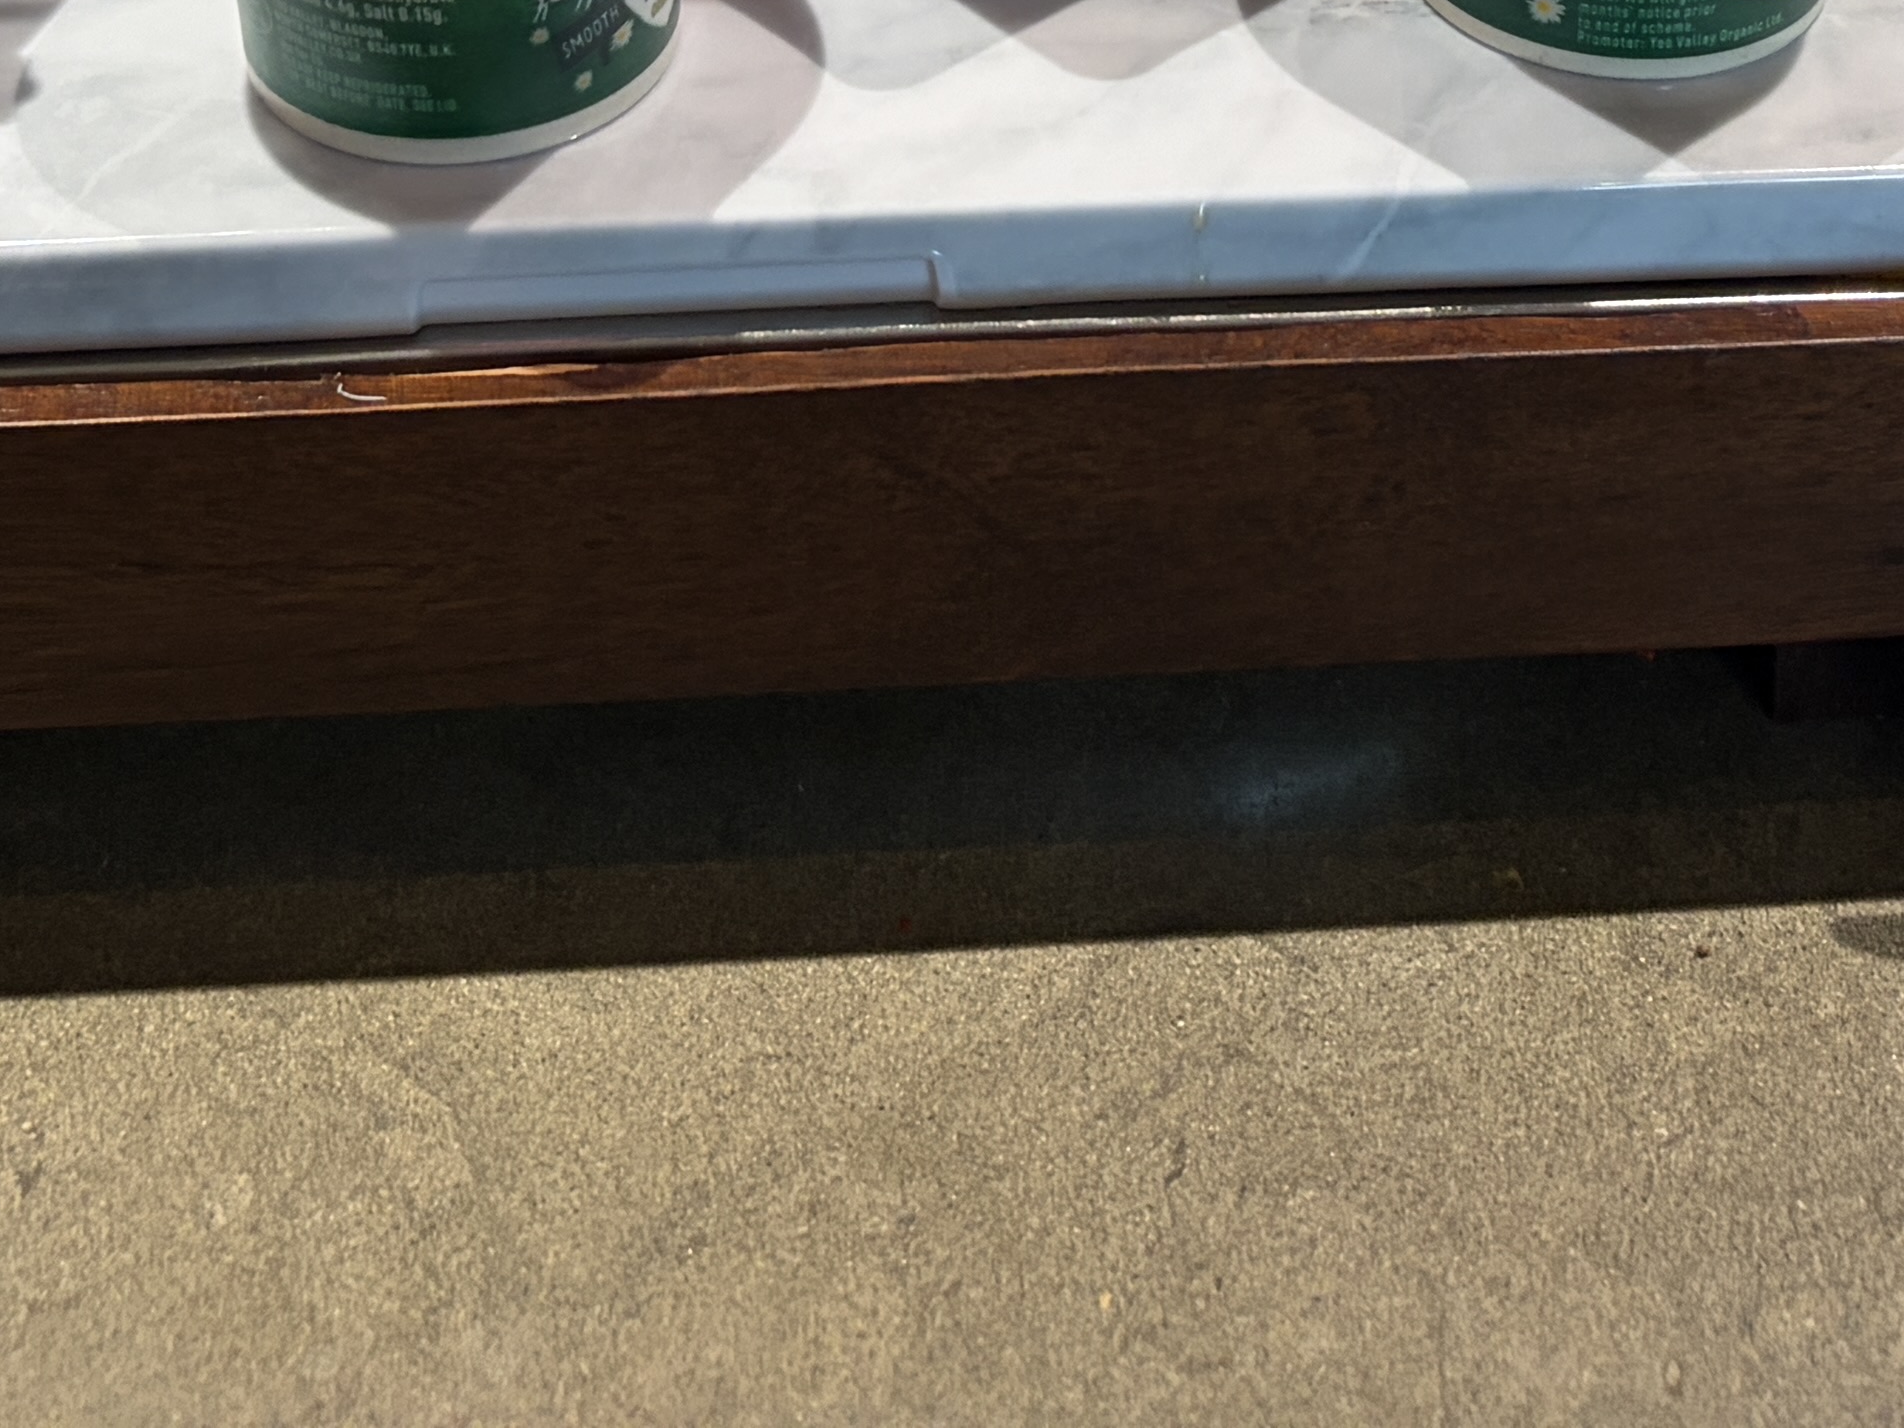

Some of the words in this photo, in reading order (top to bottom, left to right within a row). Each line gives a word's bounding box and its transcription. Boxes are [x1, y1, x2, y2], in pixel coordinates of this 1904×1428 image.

[561, 4, 621, 60] SMOOTH
[1676, 33, 1718, 50] Valley
[1719, 25, 1764, 43] Organic
